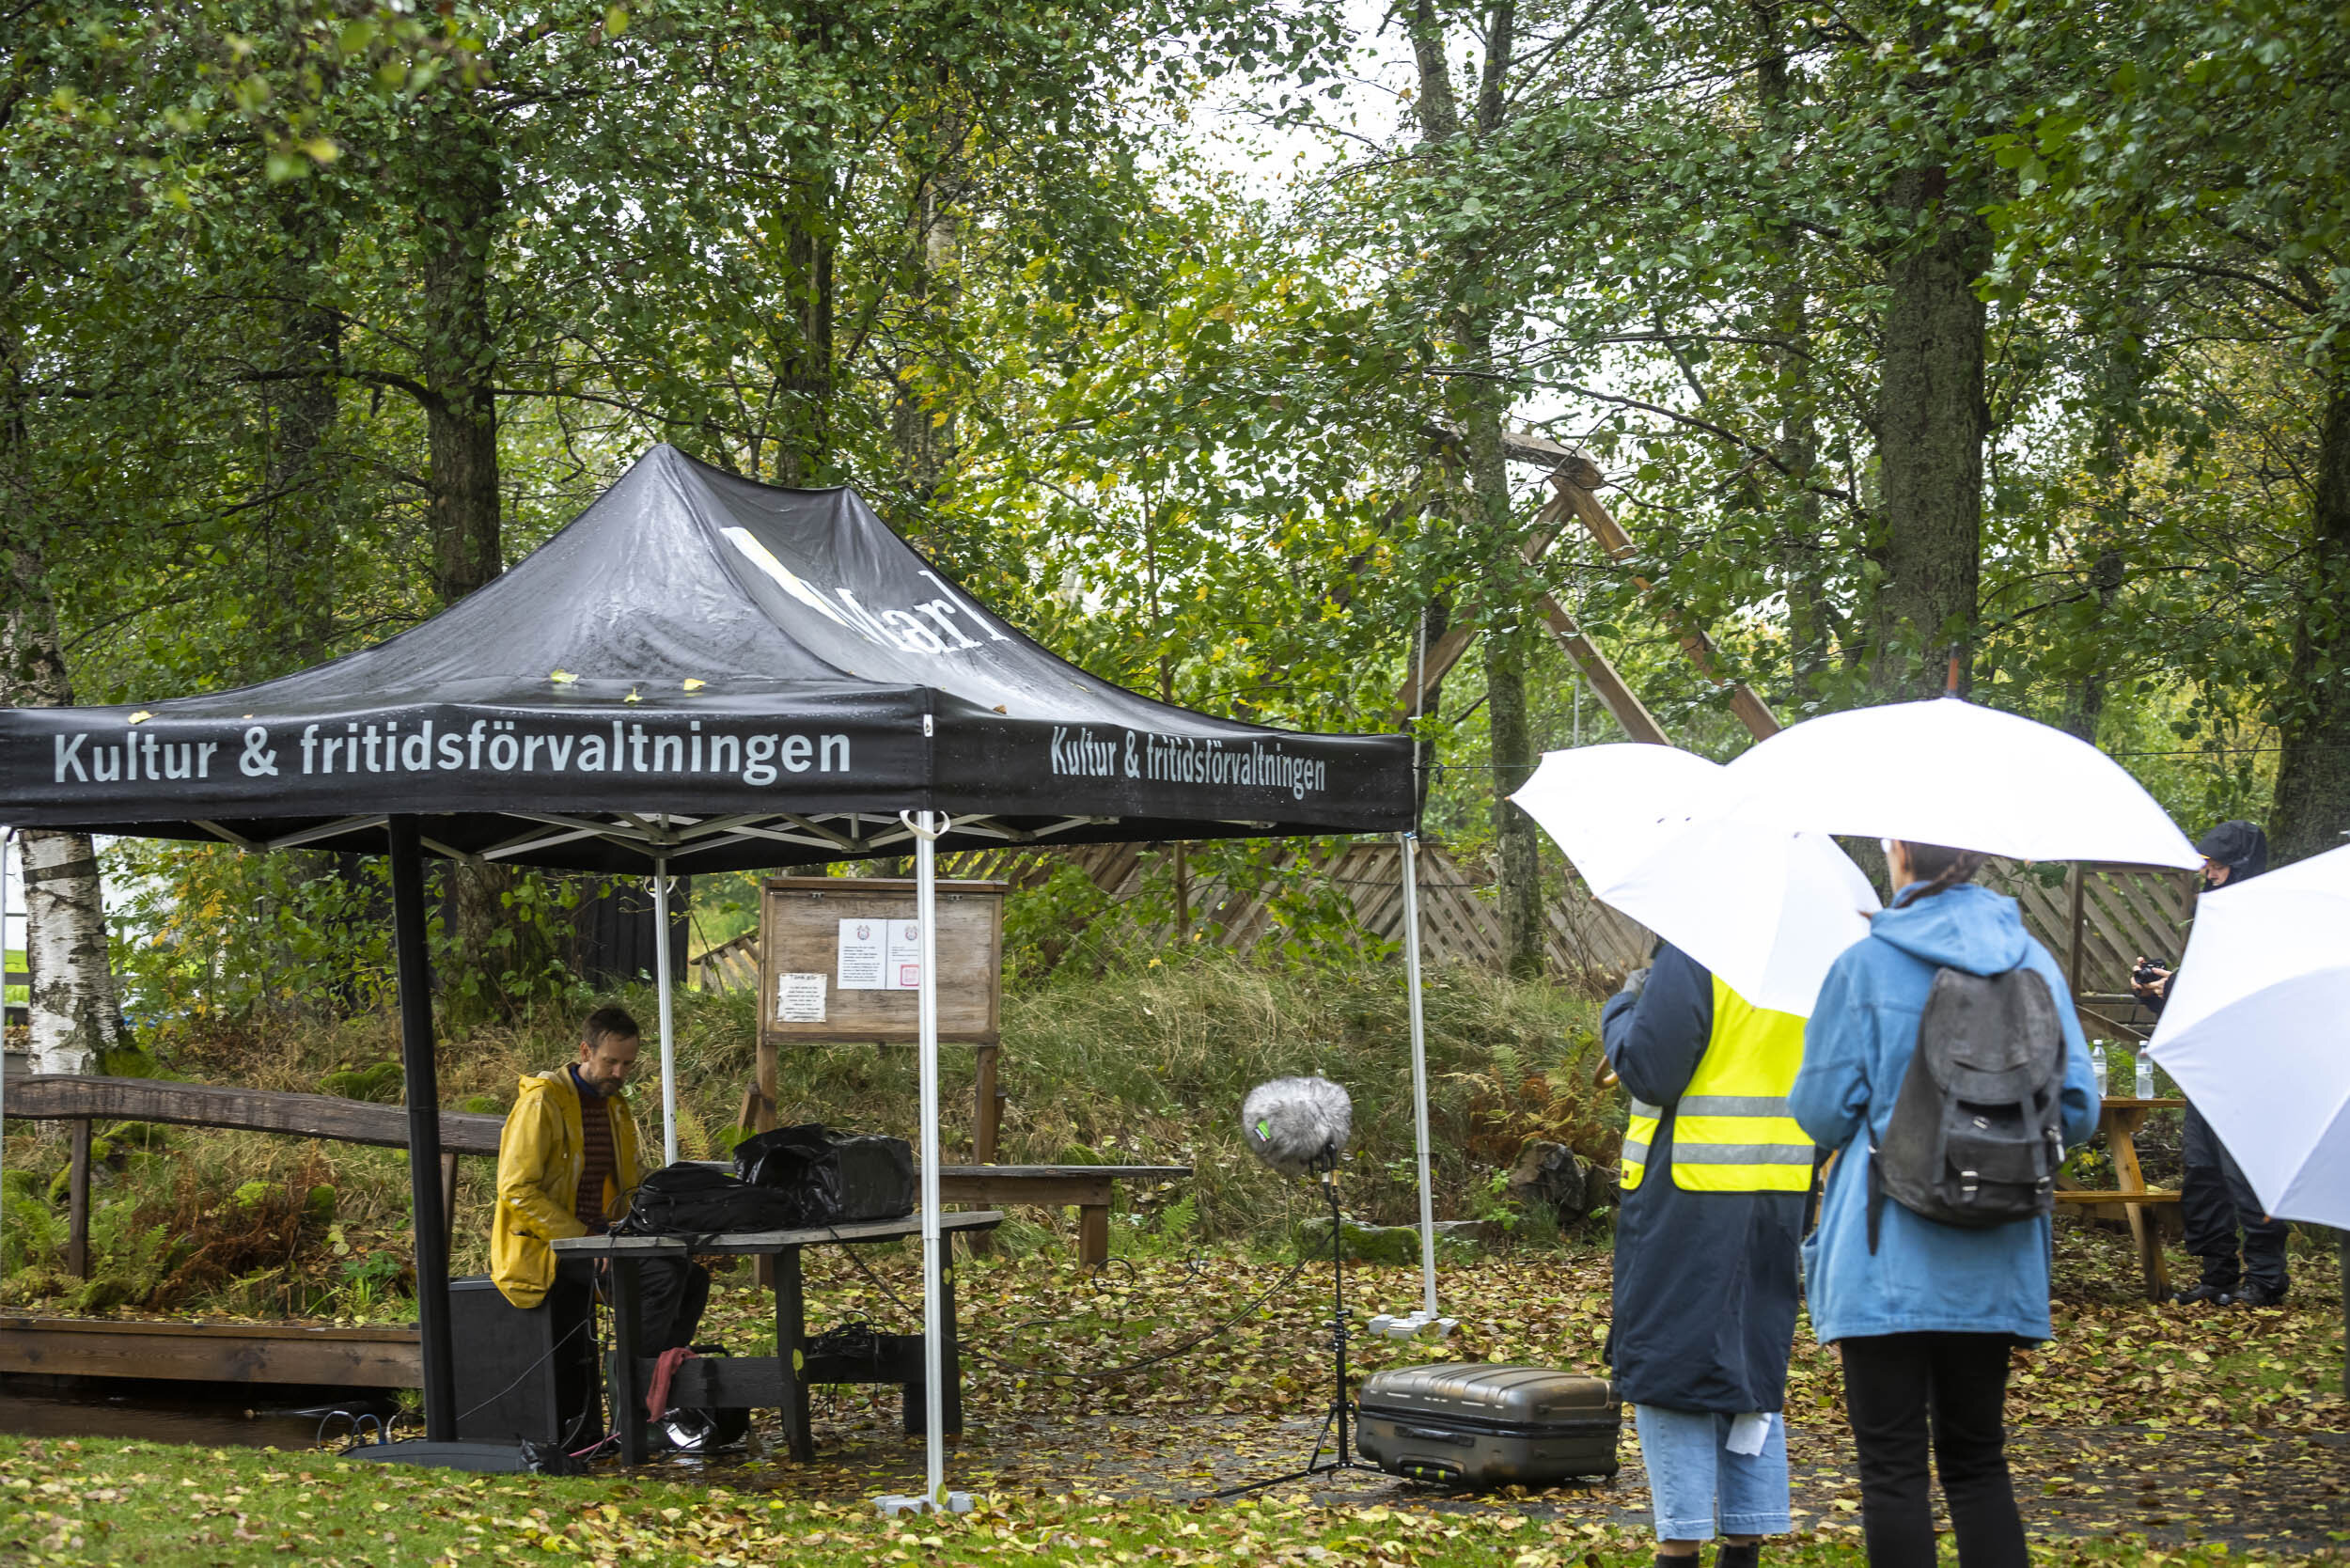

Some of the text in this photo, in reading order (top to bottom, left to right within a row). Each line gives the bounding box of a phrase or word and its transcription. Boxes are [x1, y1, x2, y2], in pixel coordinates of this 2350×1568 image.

[55, 720, 850, 786] Kultur & fritidsförvaltningen
[1051, 726, 1325, 800] Kultur & fritidsförvaltningen
